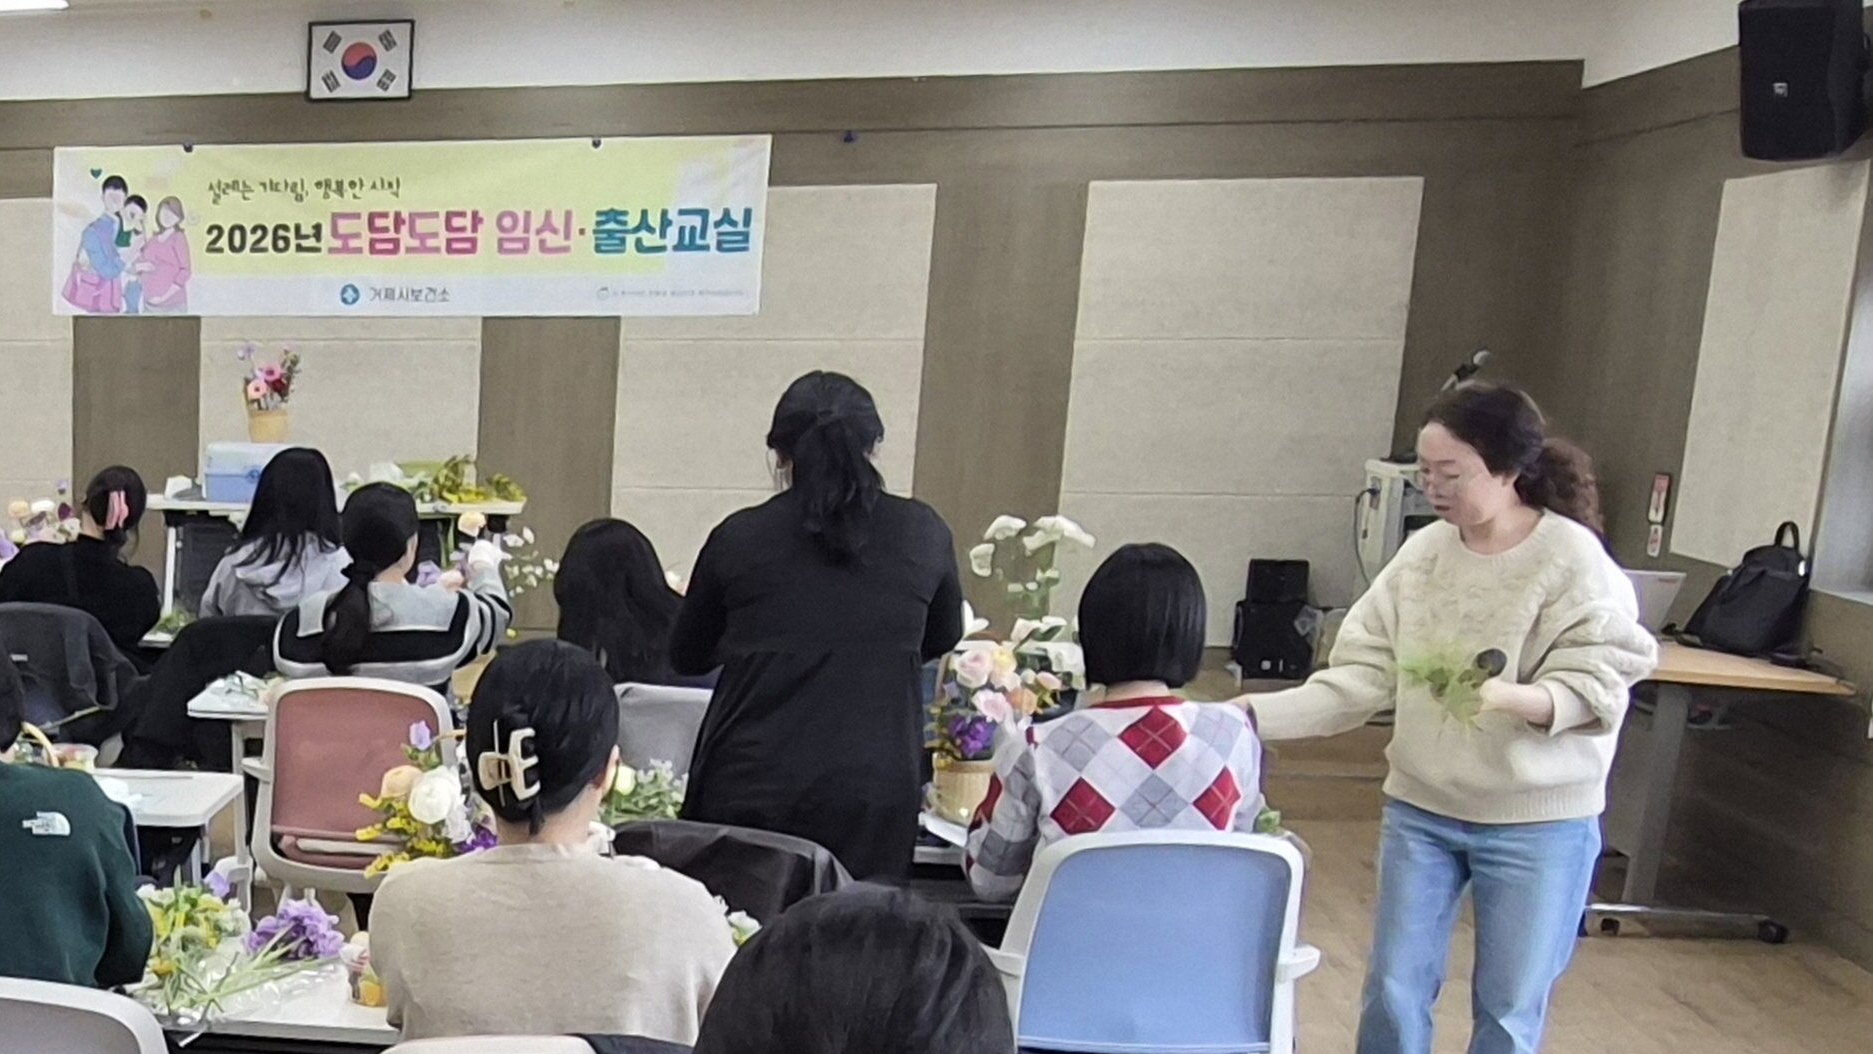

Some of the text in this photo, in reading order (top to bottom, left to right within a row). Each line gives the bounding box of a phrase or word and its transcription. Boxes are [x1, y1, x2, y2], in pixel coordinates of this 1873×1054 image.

[208, 178, 254, 205] 설레는
[205, 222, 323, 254] 2026년
[327, 209, 485, 255] 도담도담
